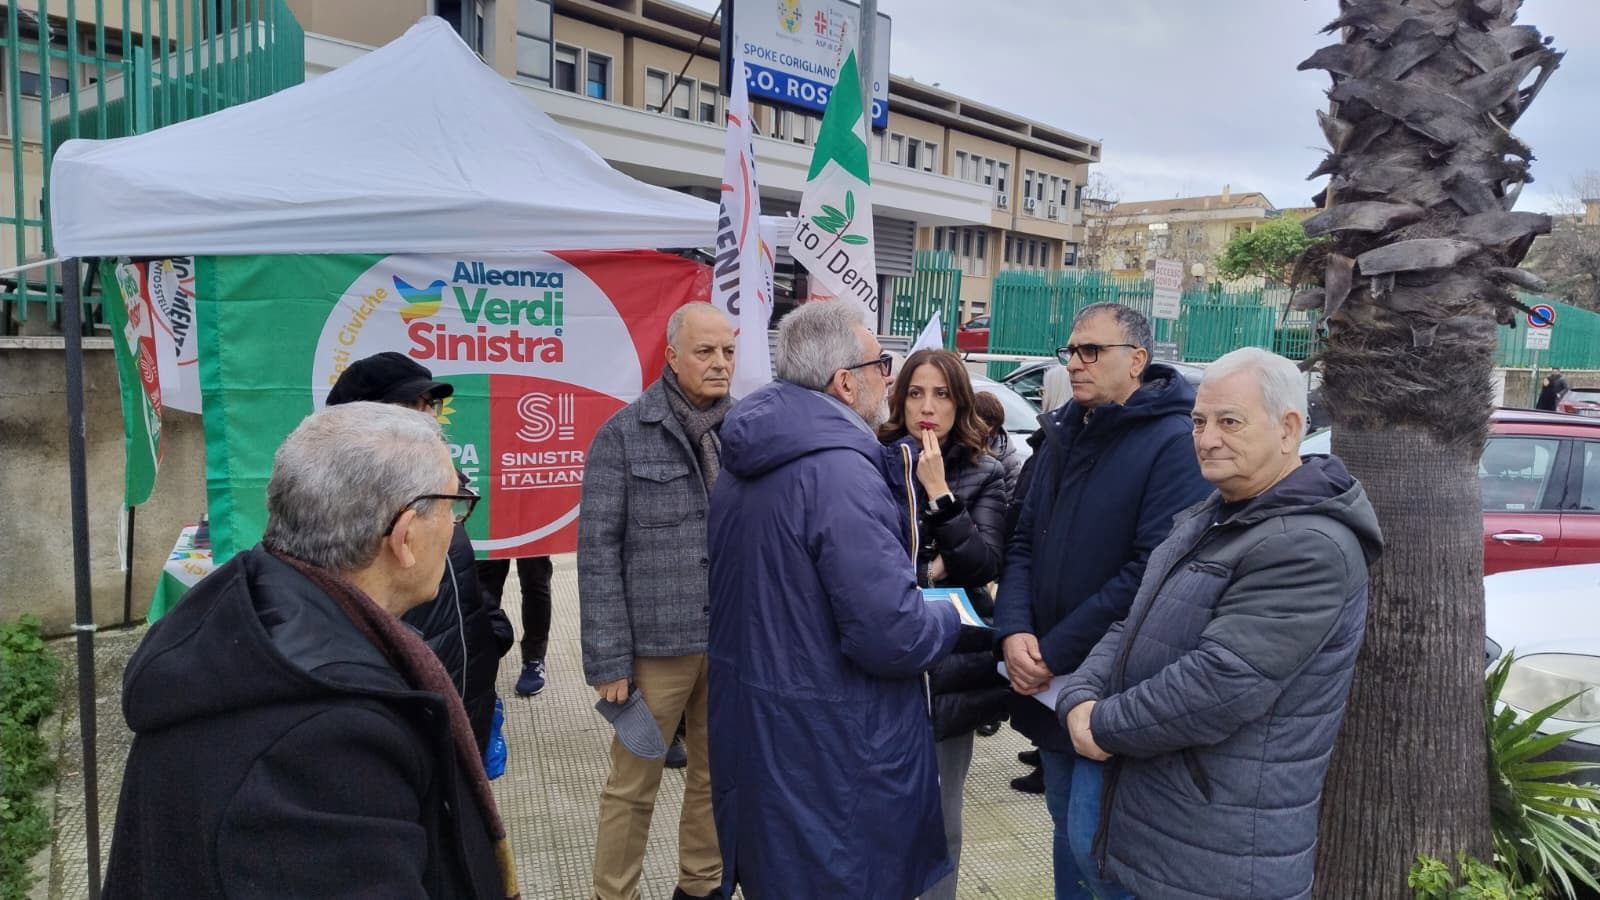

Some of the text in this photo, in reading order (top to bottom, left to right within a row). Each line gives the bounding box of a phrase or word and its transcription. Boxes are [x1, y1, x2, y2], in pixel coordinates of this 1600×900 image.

[744, 42, 836, 80] SPOKE CORIGLIANO
[452, 261, 563, 289] Alleanza
[338, 288, 388, 346] Civiche
[452, 286, 563, 327] Verdi
[407, 321, 563, 364] Sinistra
[554, 327, 563, 337] e
[501, 450, 584, 466] SINISTR
[501, 470, 584, 486] ITALIAN
